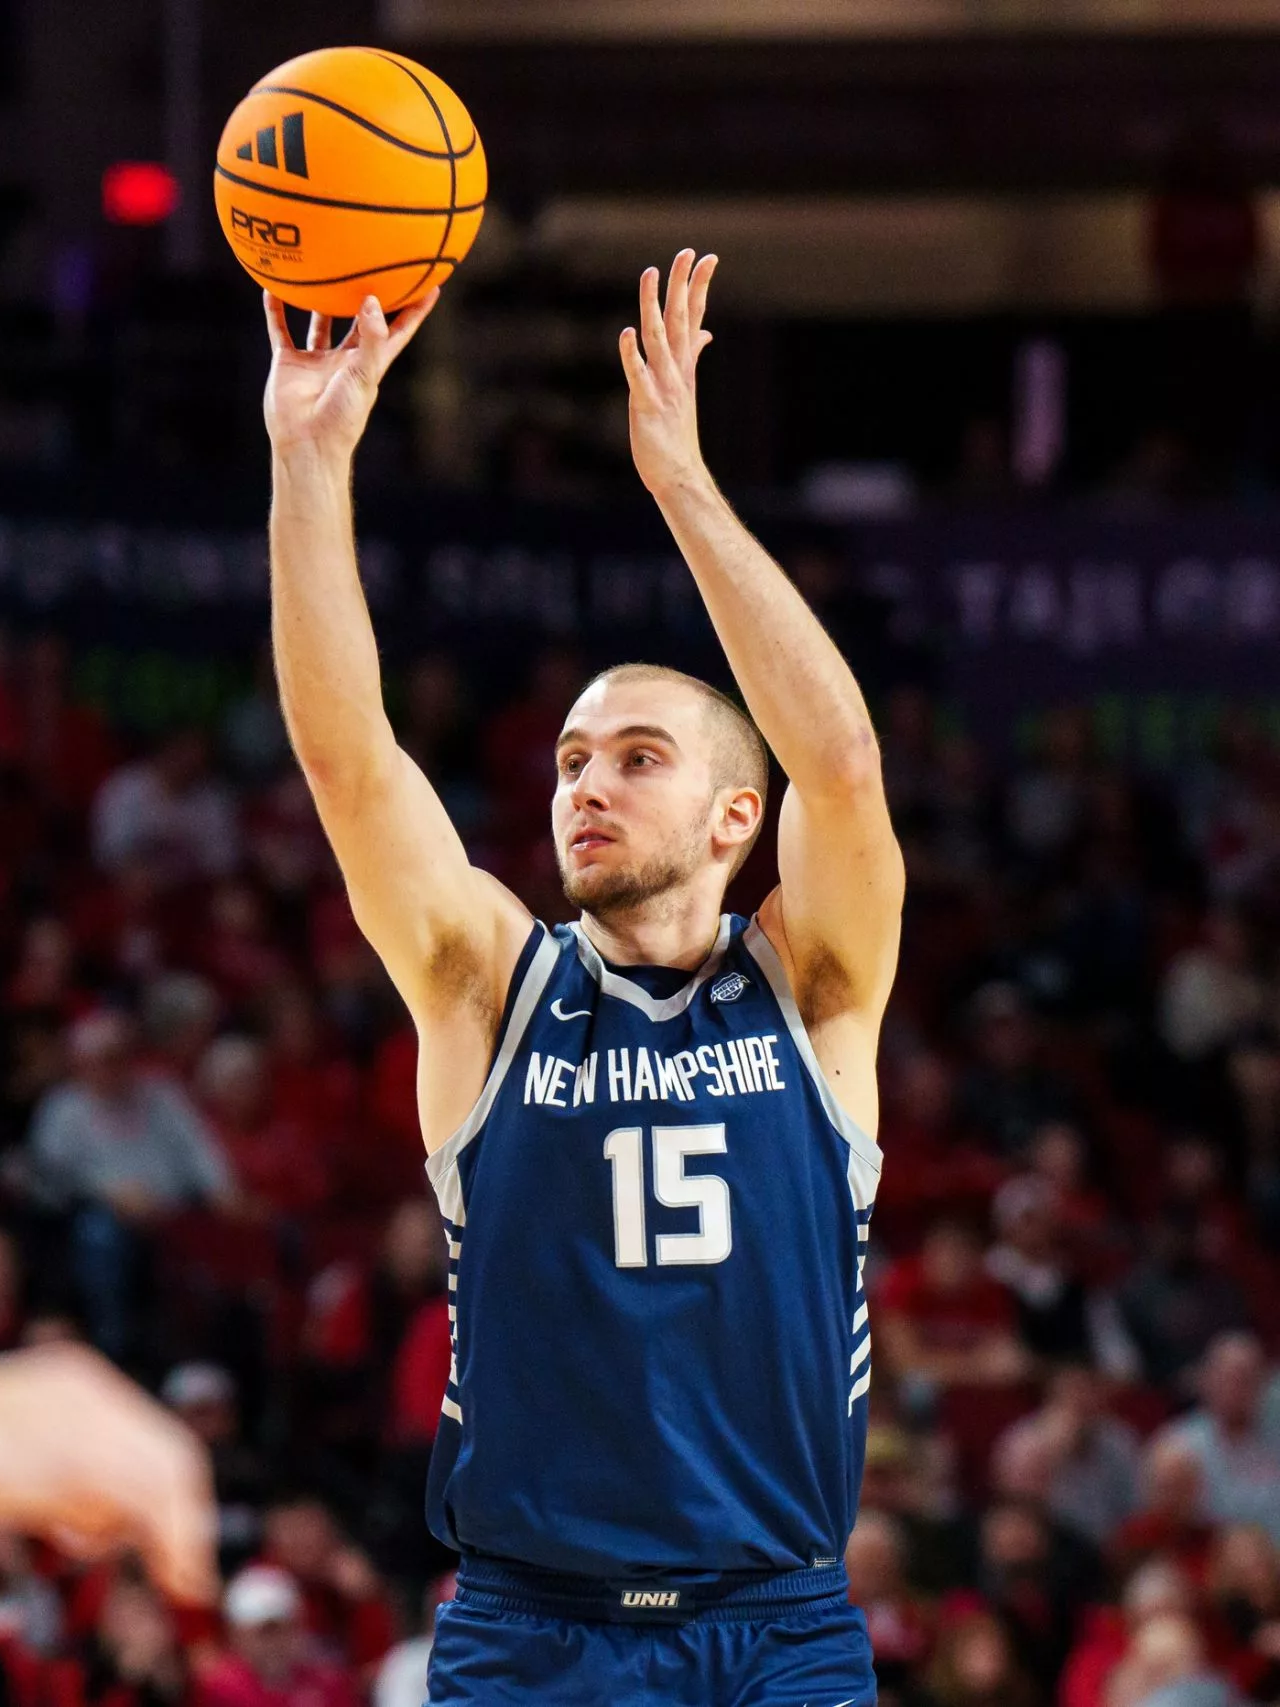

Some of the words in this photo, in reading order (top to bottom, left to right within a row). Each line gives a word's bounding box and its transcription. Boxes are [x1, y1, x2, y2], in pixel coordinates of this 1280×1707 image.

[231, 206, 301, 247] PRO
[523, 1051, 598, 1108] NEW
[607, 1034, 786, 1102] HAMPSHIRE
[603, 1122, 733, 1268] 15
[623, 1592, 678, 1606] UNH
